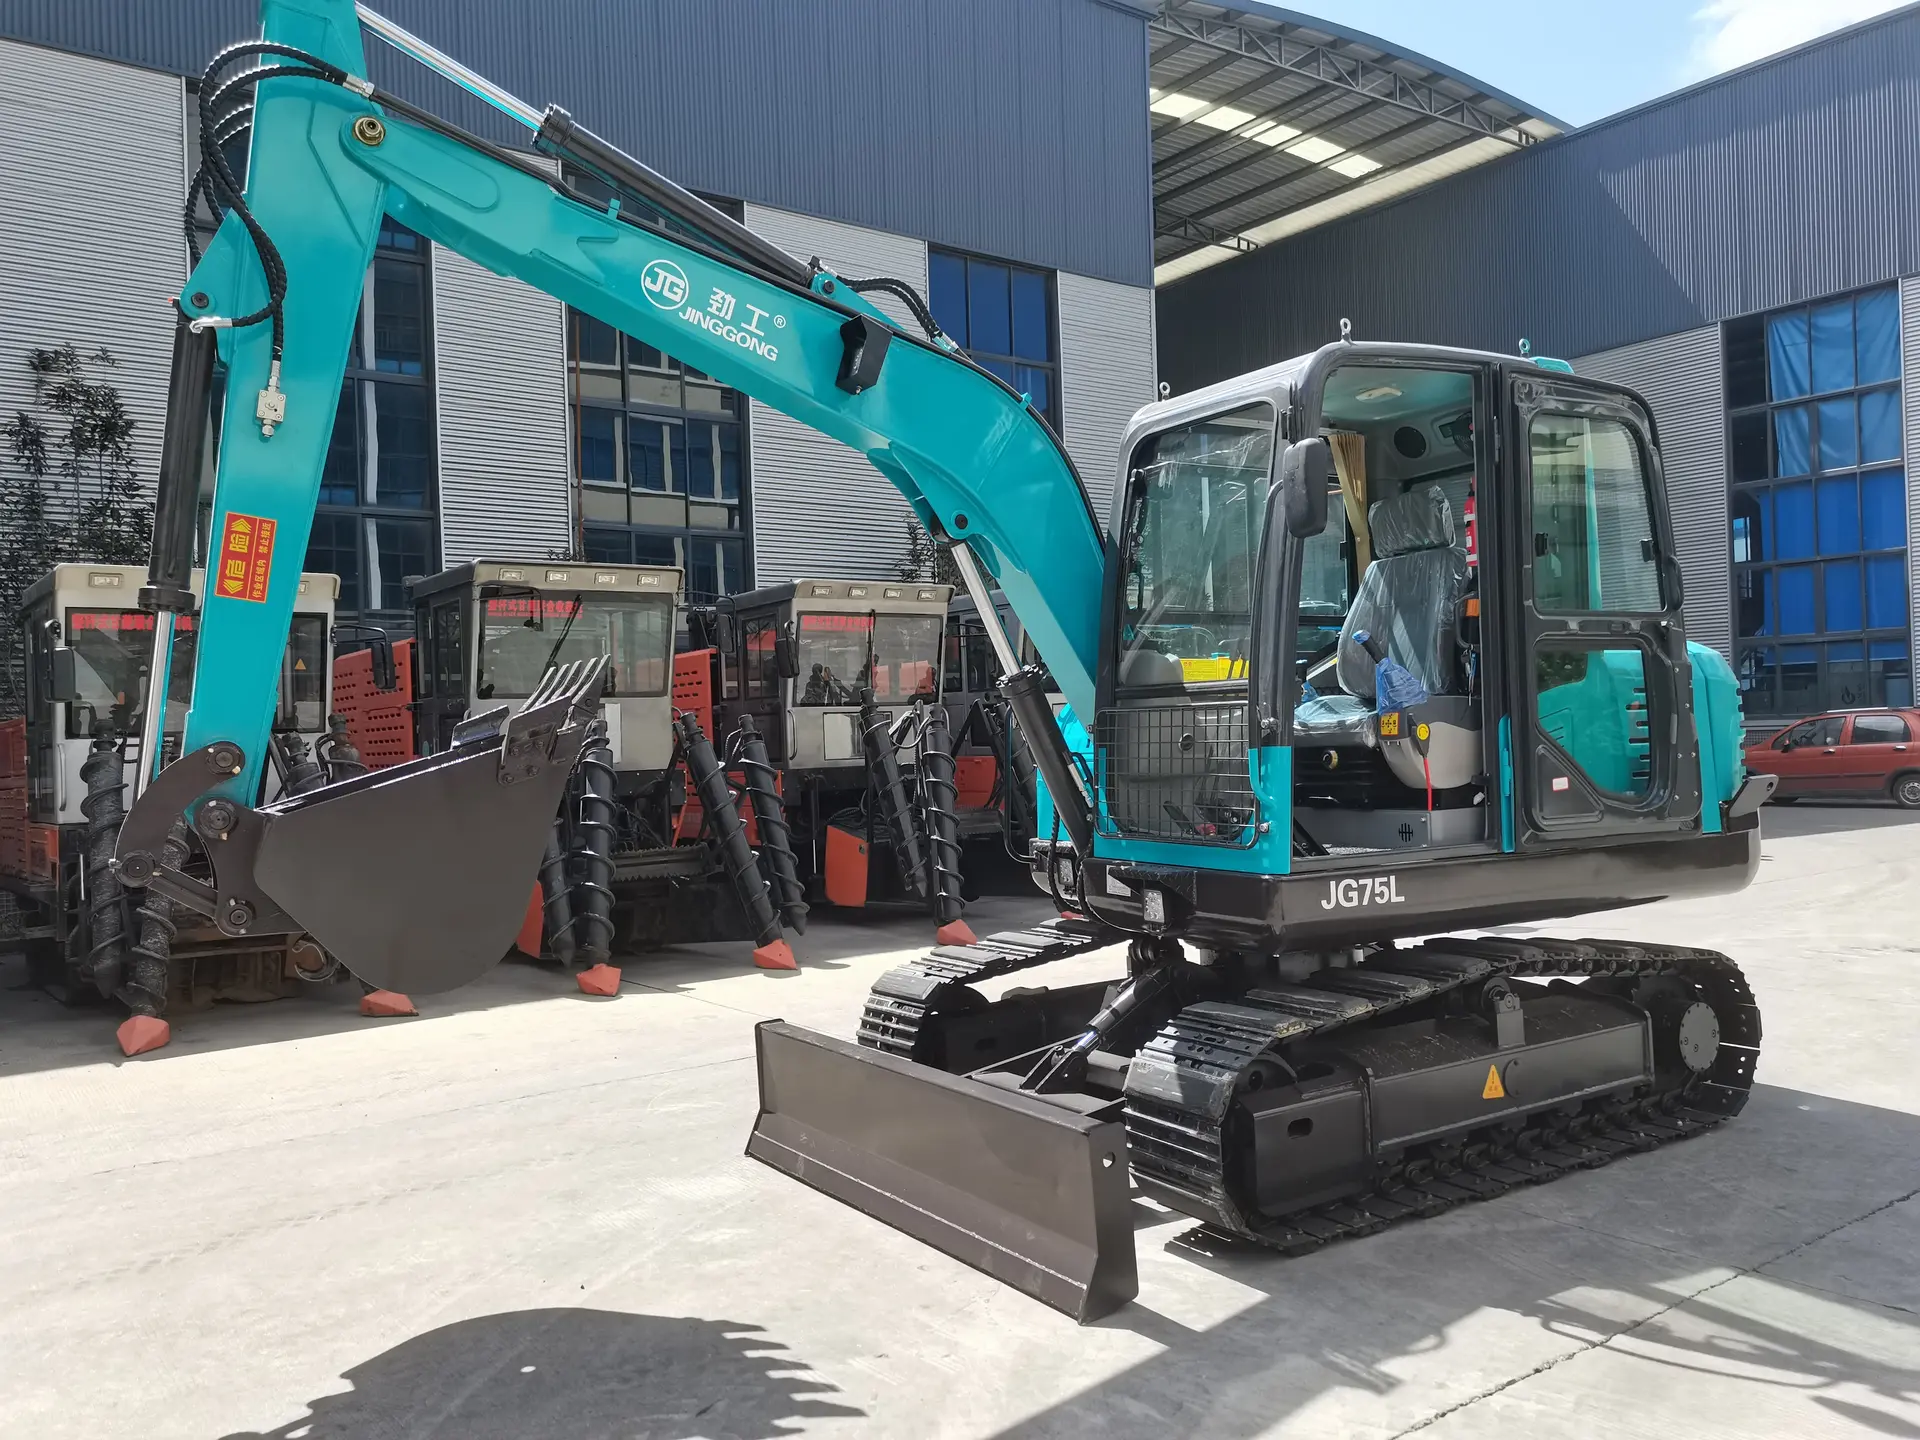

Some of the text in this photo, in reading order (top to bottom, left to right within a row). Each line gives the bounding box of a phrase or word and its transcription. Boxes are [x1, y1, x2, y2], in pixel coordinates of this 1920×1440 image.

[644, 266, 686, 303] JG
[678, 306, 779, 362] JINGGONG
[707, 287, 770, 337] 劲工
[225, 533, 250, 579] 危险
[252, 522, 272, 598] 作业区域内 禁止接近
[1320, 875, 1405, 910] JG75L
